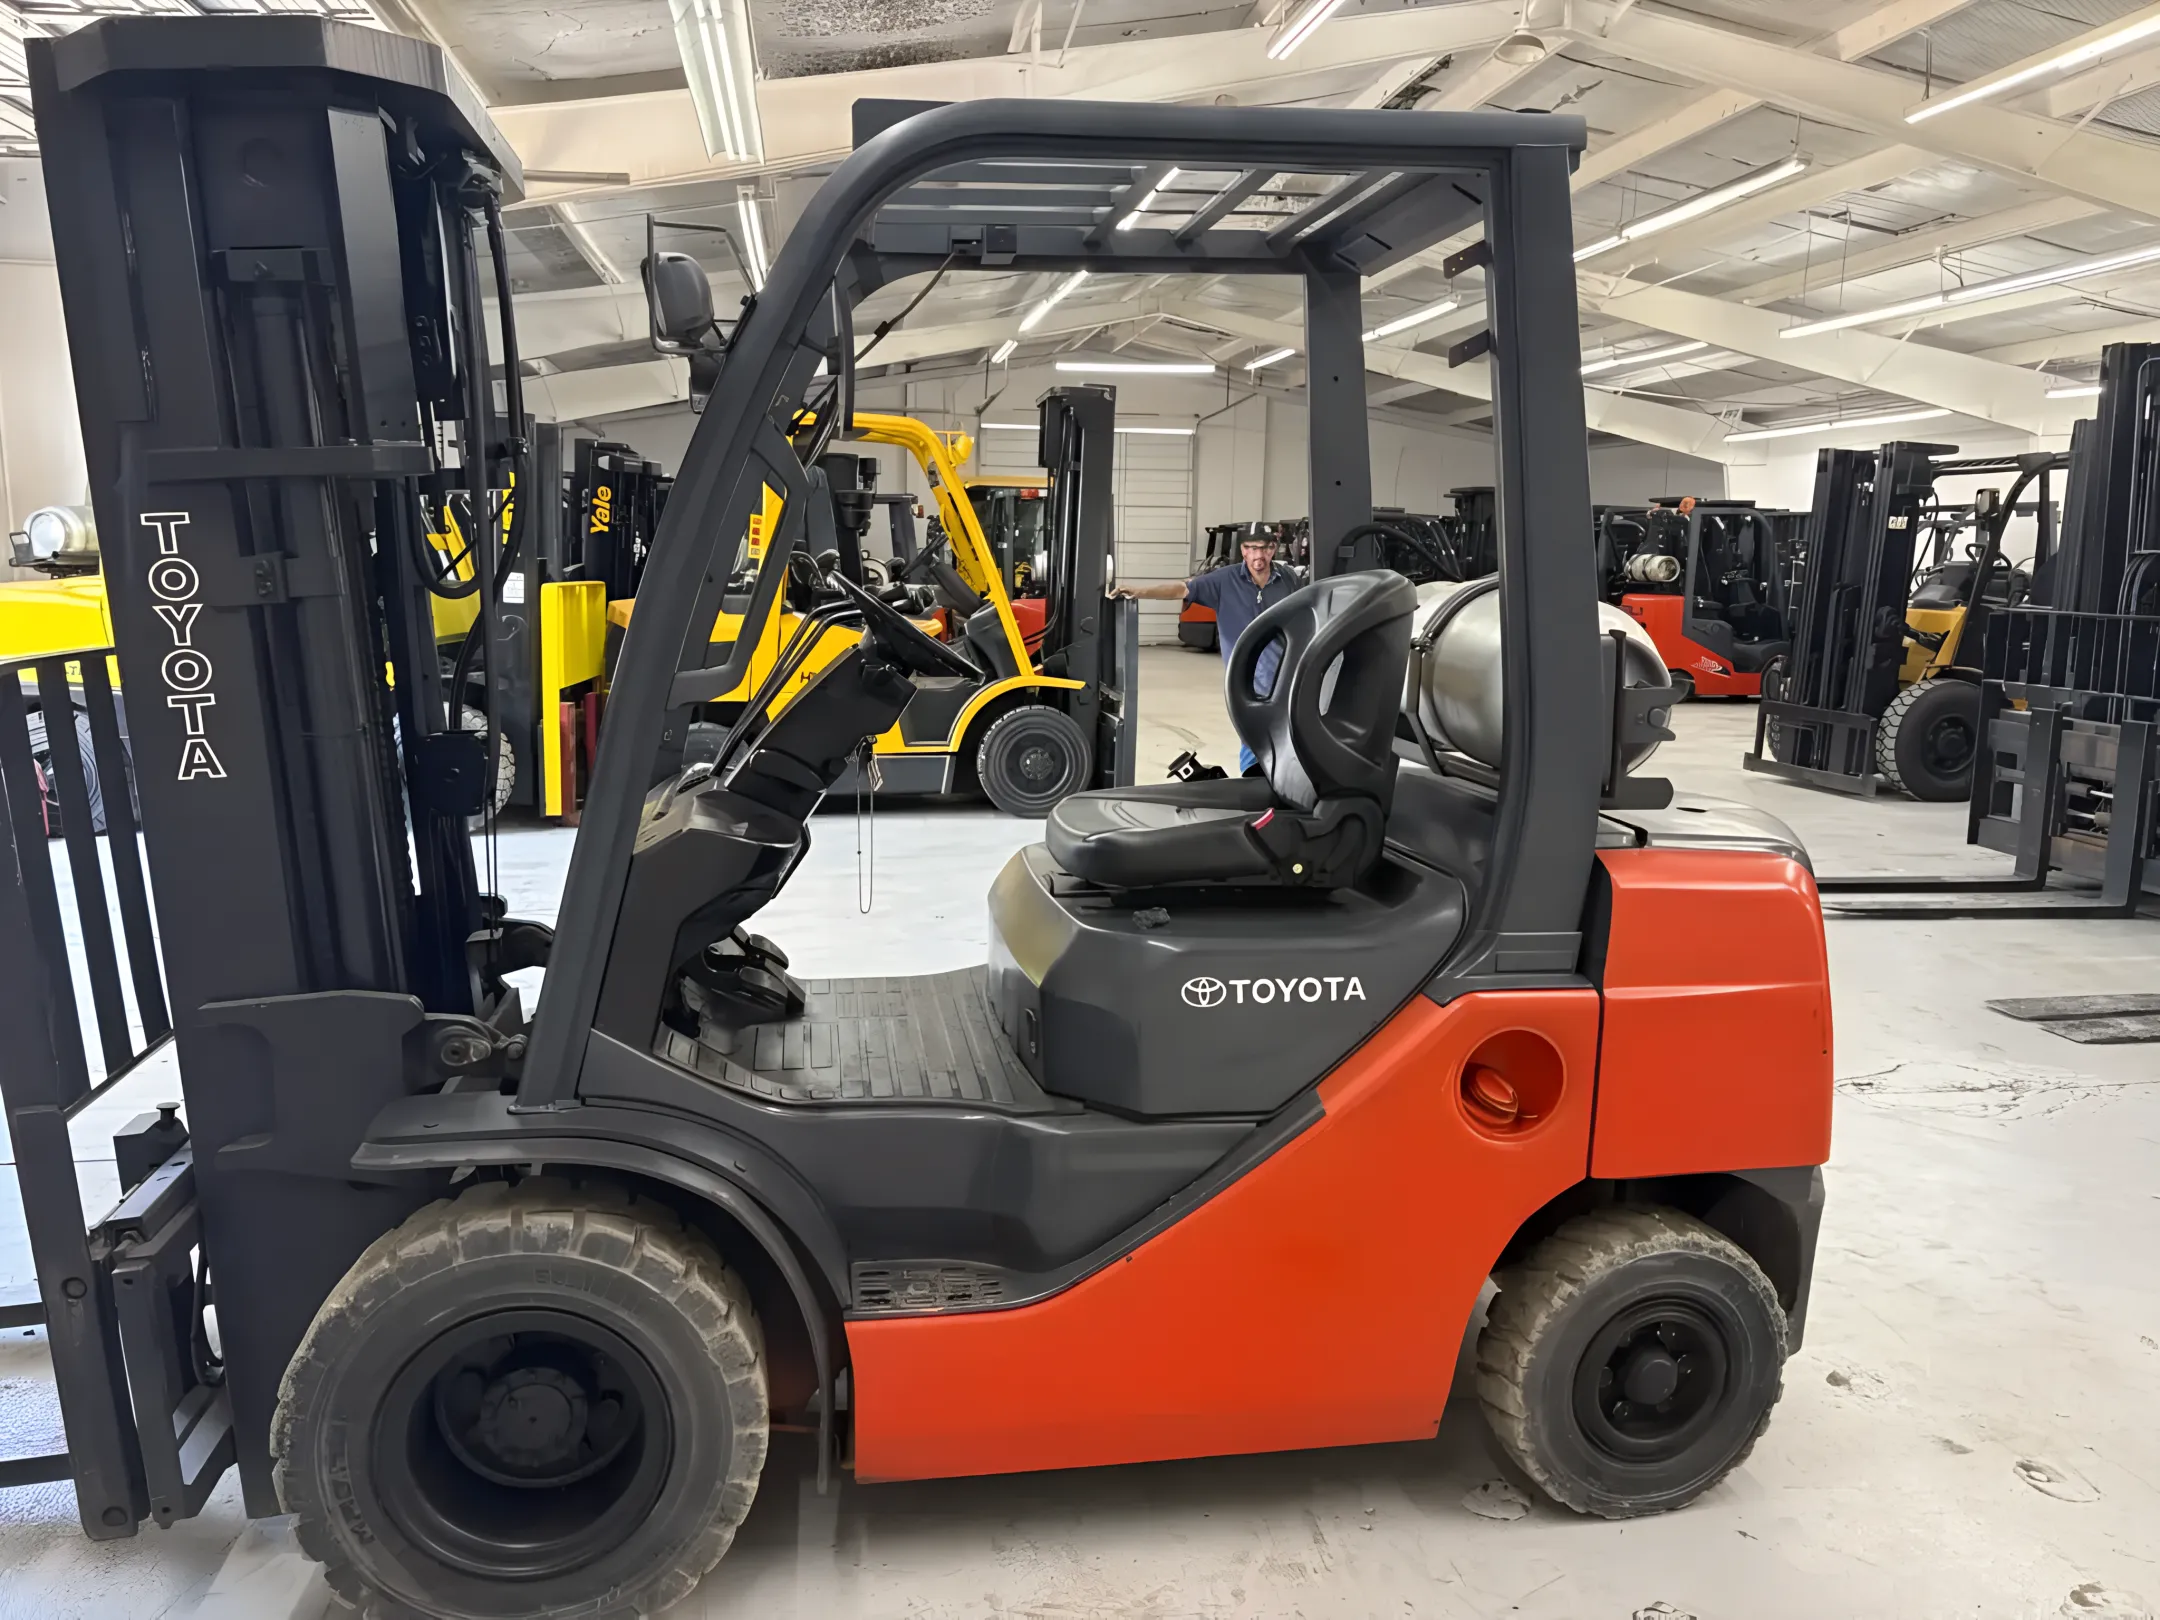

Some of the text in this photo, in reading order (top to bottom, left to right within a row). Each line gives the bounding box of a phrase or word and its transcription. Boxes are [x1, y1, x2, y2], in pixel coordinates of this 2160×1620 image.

[590, 485, 612, 534] Yale
[139, 511, 228, 781] TOYOTA
[1228, 976, 1367, 1004] TOYOTA
